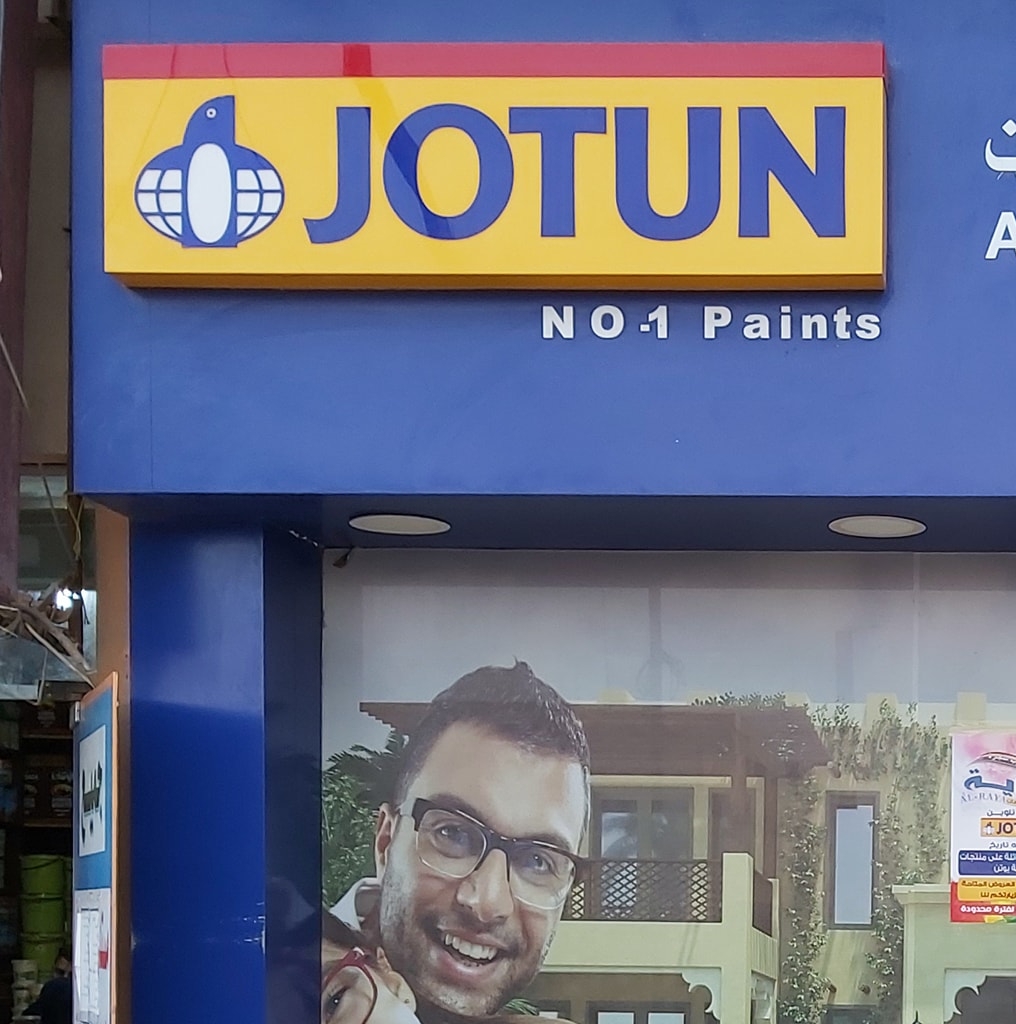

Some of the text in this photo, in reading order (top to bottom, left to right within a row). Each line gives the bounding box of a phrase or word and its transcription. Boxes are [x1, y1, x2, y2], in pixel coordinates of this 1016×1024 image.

[303, 104, 847, 245] JOTUN
[705, 305, 882, 341] Paints
[987, 809, 1015, 817] تلوين
[960, 852, 986, 863] منتجات
[960, 905, 992, 914] محدودة
